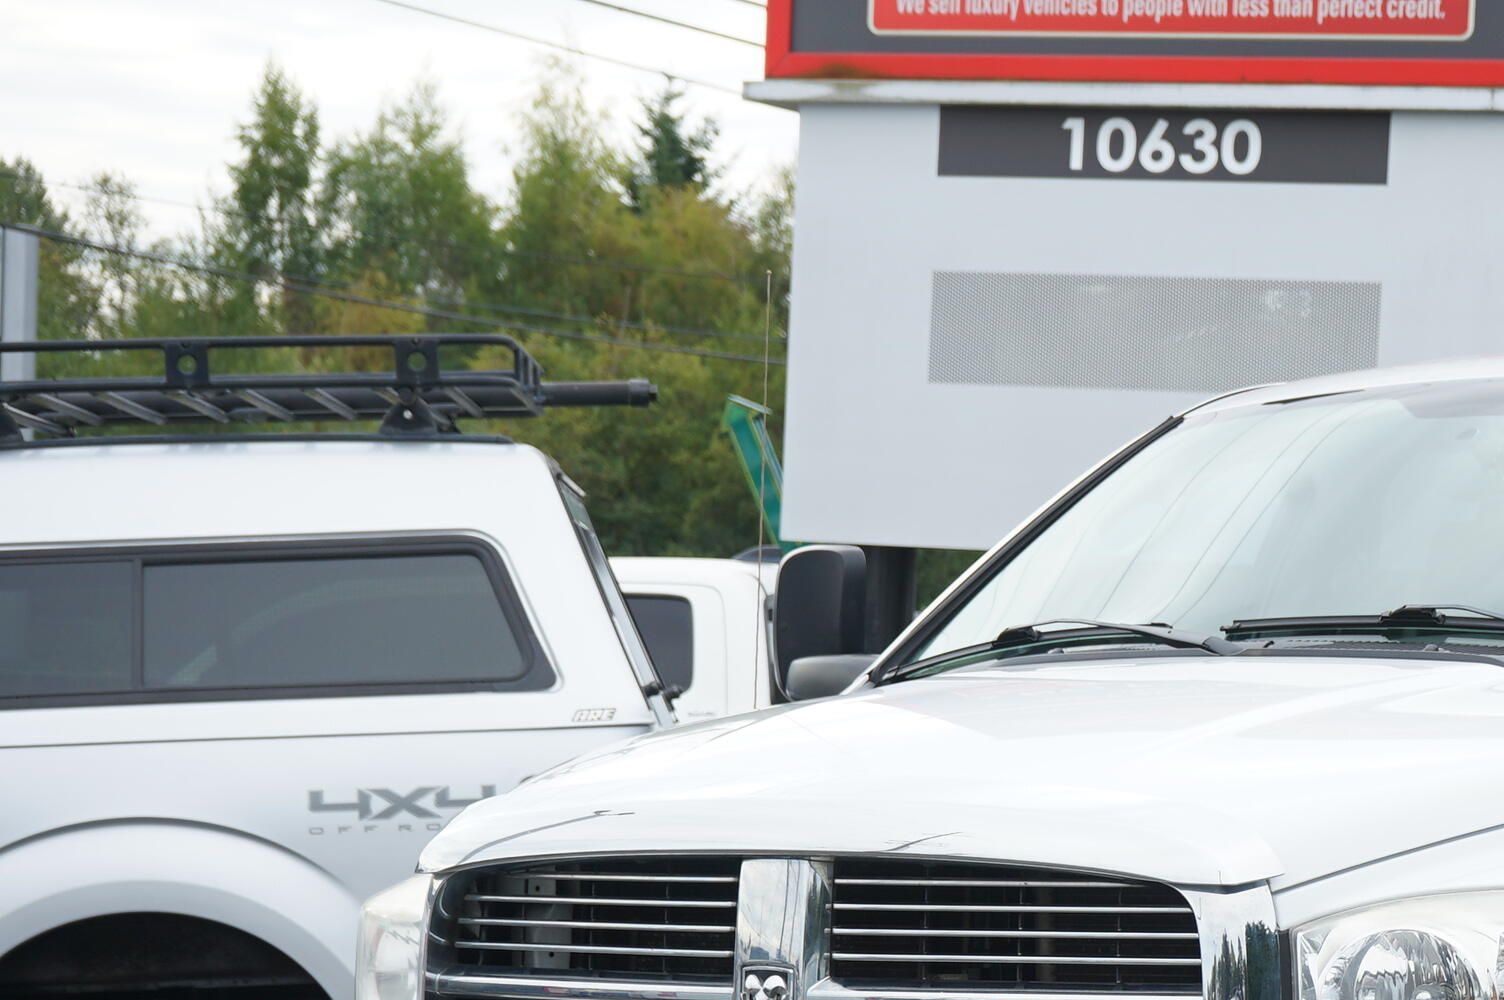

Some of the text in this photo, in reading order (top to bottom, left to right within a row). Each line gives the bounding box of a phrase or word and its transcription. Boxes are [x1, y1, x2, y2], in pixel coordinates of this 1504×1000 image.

[897, 0, 1446, 25] We sell luxury vehicles to people with less than perfect credit.
[1061, 116, 1263, 176] 10630
[308, 824, 379, 836] OFF
